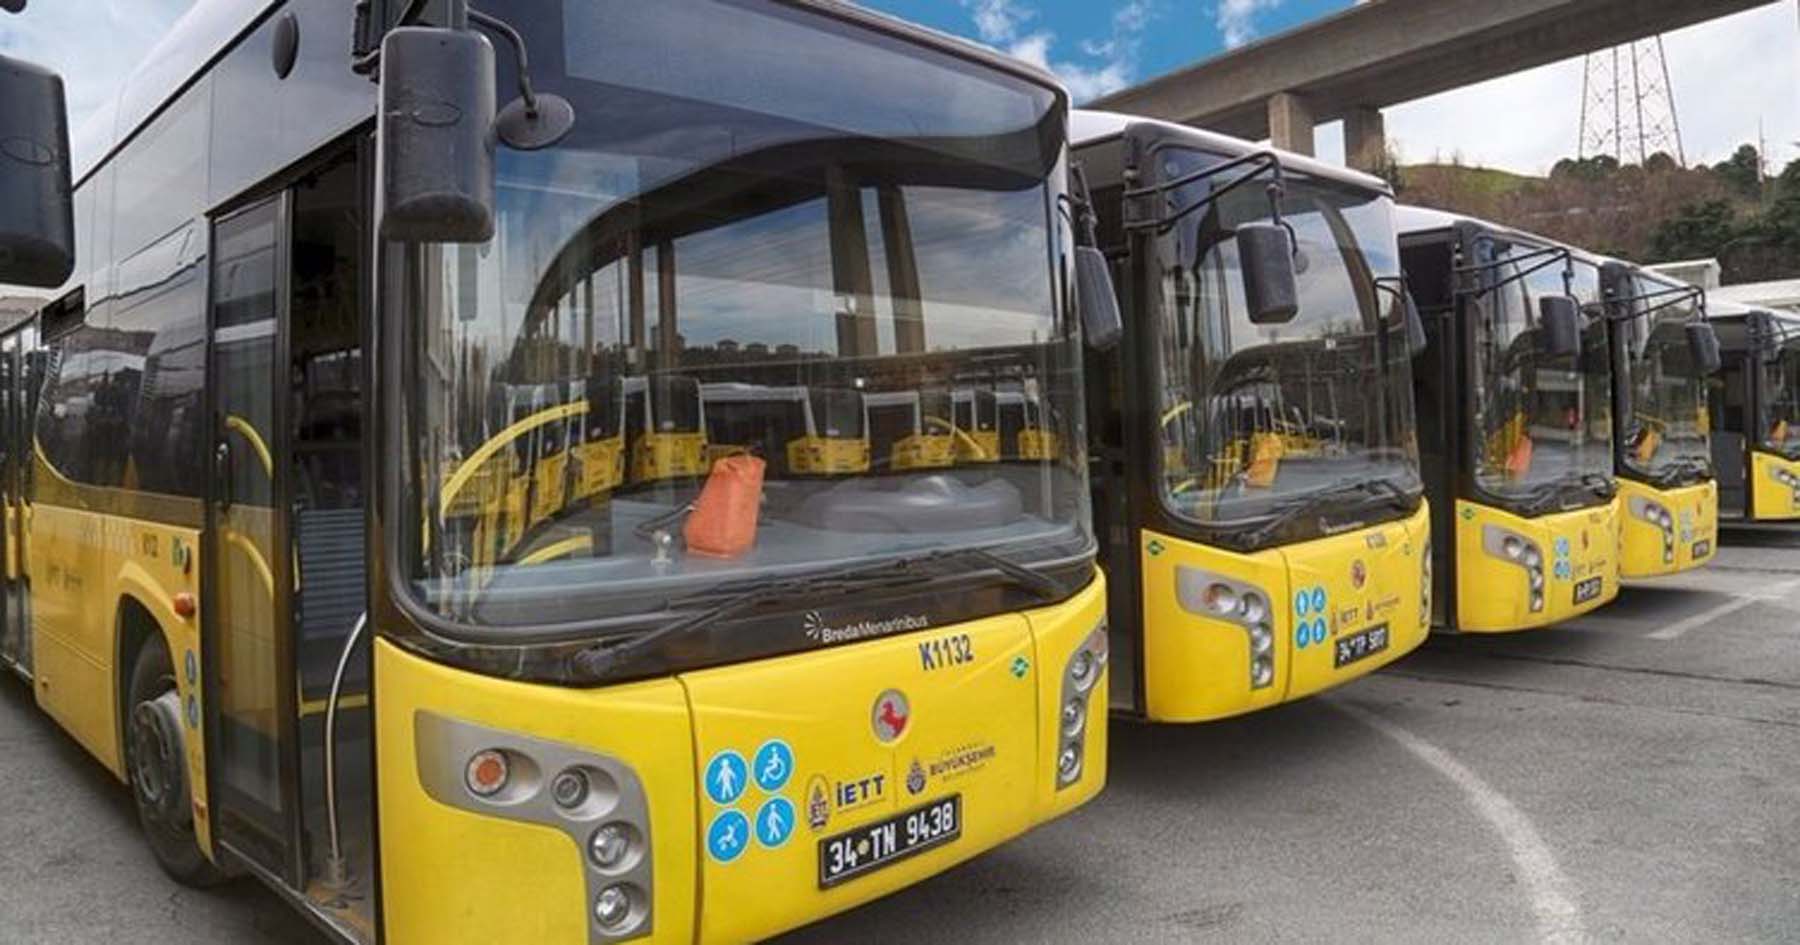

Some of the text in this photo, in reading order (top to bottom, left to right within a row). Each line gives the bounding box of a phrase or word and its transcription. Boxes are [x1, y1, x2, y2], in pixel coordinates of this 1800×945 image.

[918, 633, 974, 671] K1132
[835, 774, 886, 808] İETT
[828, 802, 954, 874] 34 TN 9438
